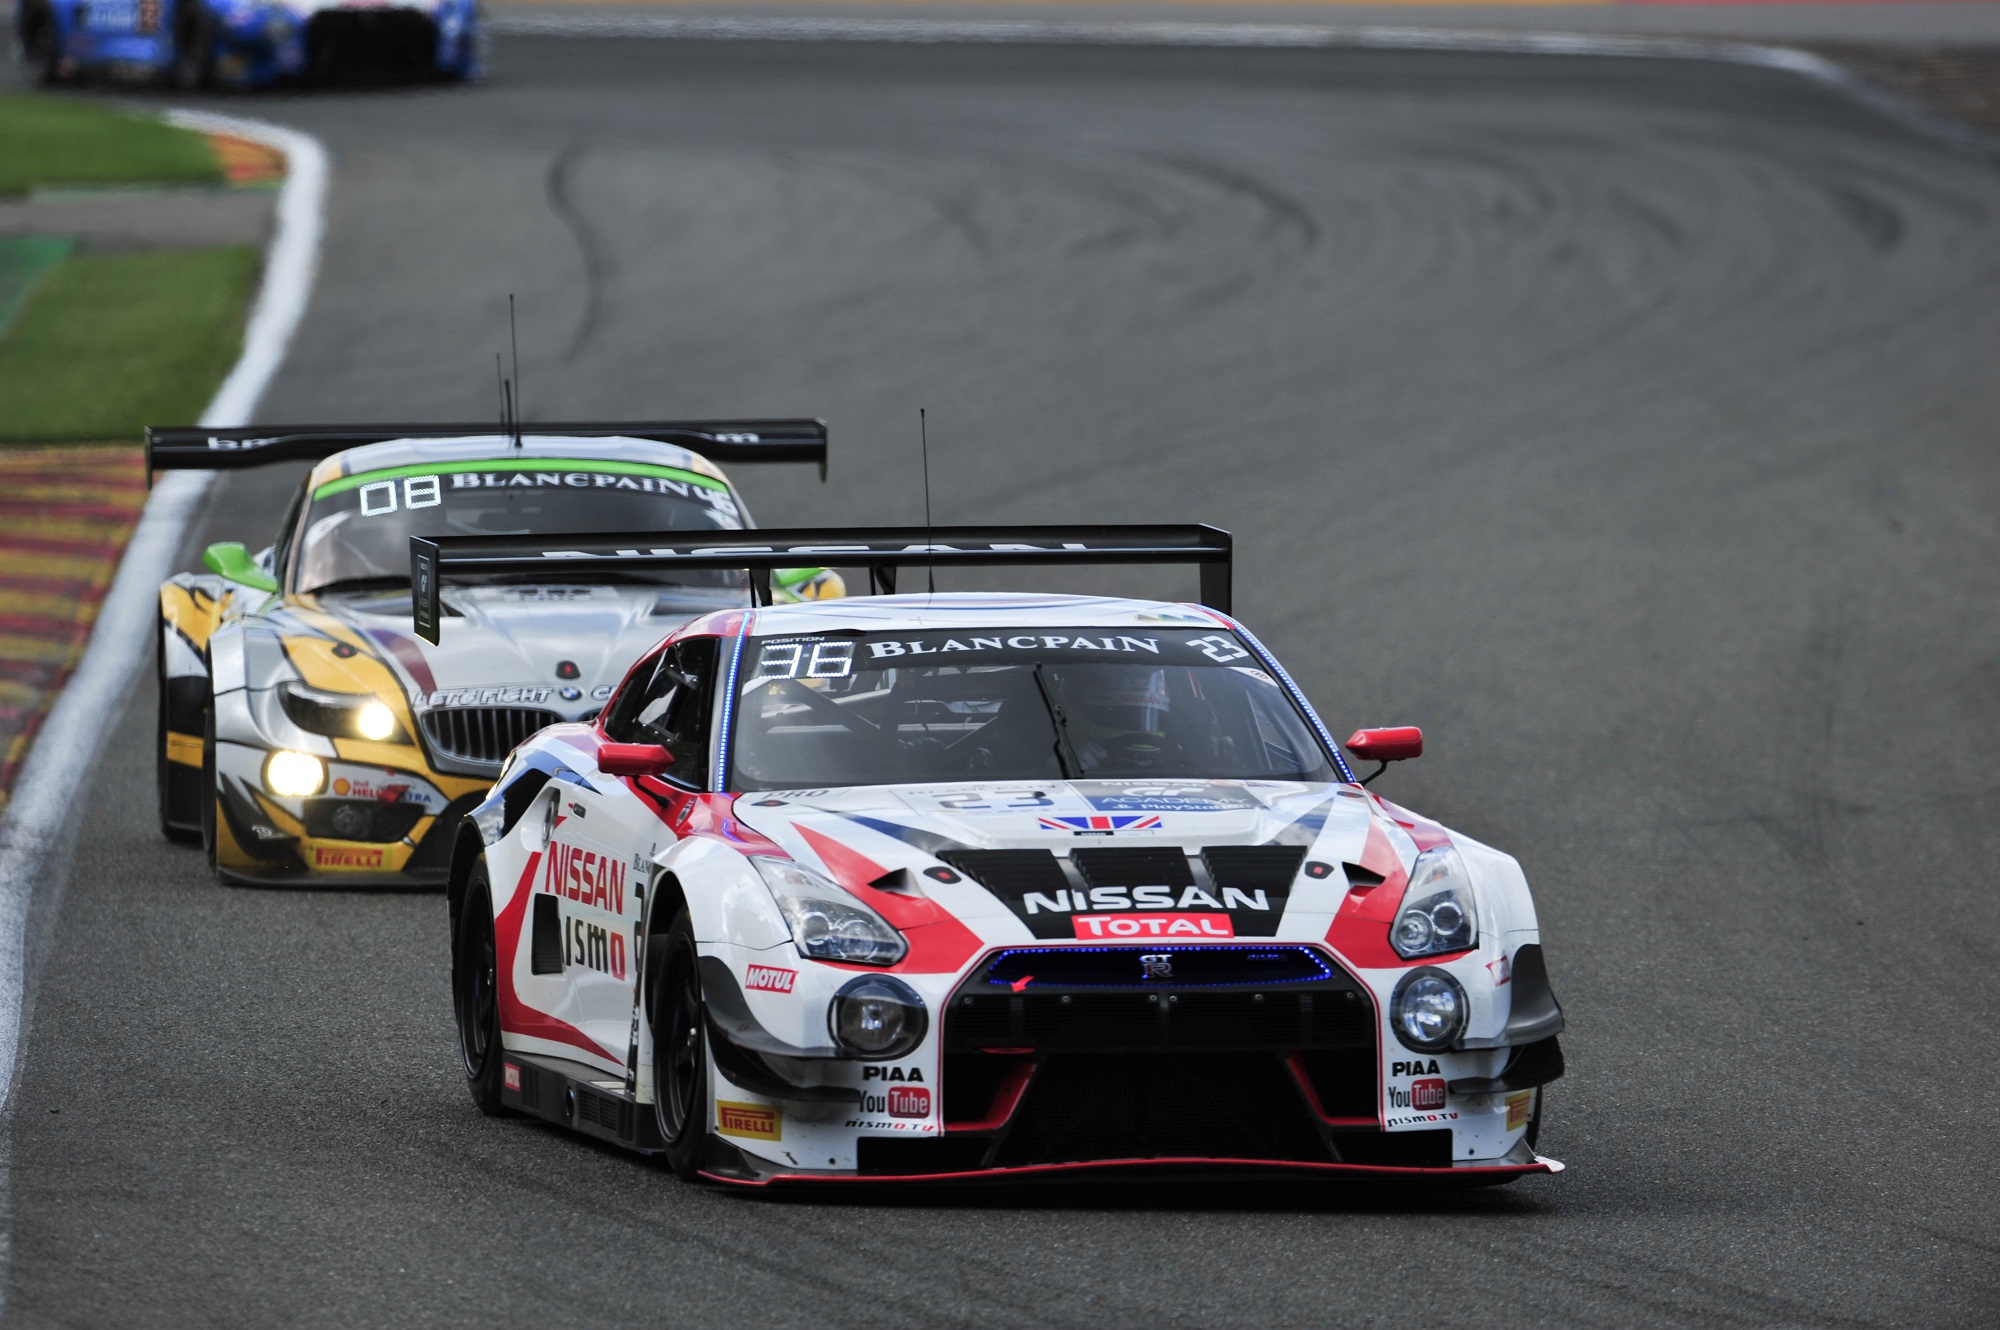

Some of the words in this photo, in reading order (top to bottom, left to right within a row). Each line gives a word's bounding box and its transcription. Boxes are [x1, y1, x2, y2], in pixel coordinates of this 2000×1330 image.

[360, 475, 441, 516] 08
[451, 472, 690, 498] BLANCPAIN
[761, 636, 825, 645] POSITION
[865, 634, 1160, 659] BLANCPAIN
[1185, 635, 1249, 663] 23
[759, 641, 855, 679] 36
[480, 686, 554, 704] FIGHT
[762, 789, 829, 799] PRO
[933, 791, 1054, 808] 23
[1141, 803, 1251, 812] PlayStation
[315, 847, 383, 867] PIRELLI
[545, 840, 626, 915] NISSAN
[1023, 886, 1270, 914] NISSAN
[1077, 917, 1229, 936] TOTAL
[562, 915, 626, 982] ismo
[746, 967, 795, 990] MOTUL
[863, 1066, 924, 1082] PIAA
[1392, 1059, 1440, 1077] PIAA
[720, 1106, 775, 1134] PIRELLI
